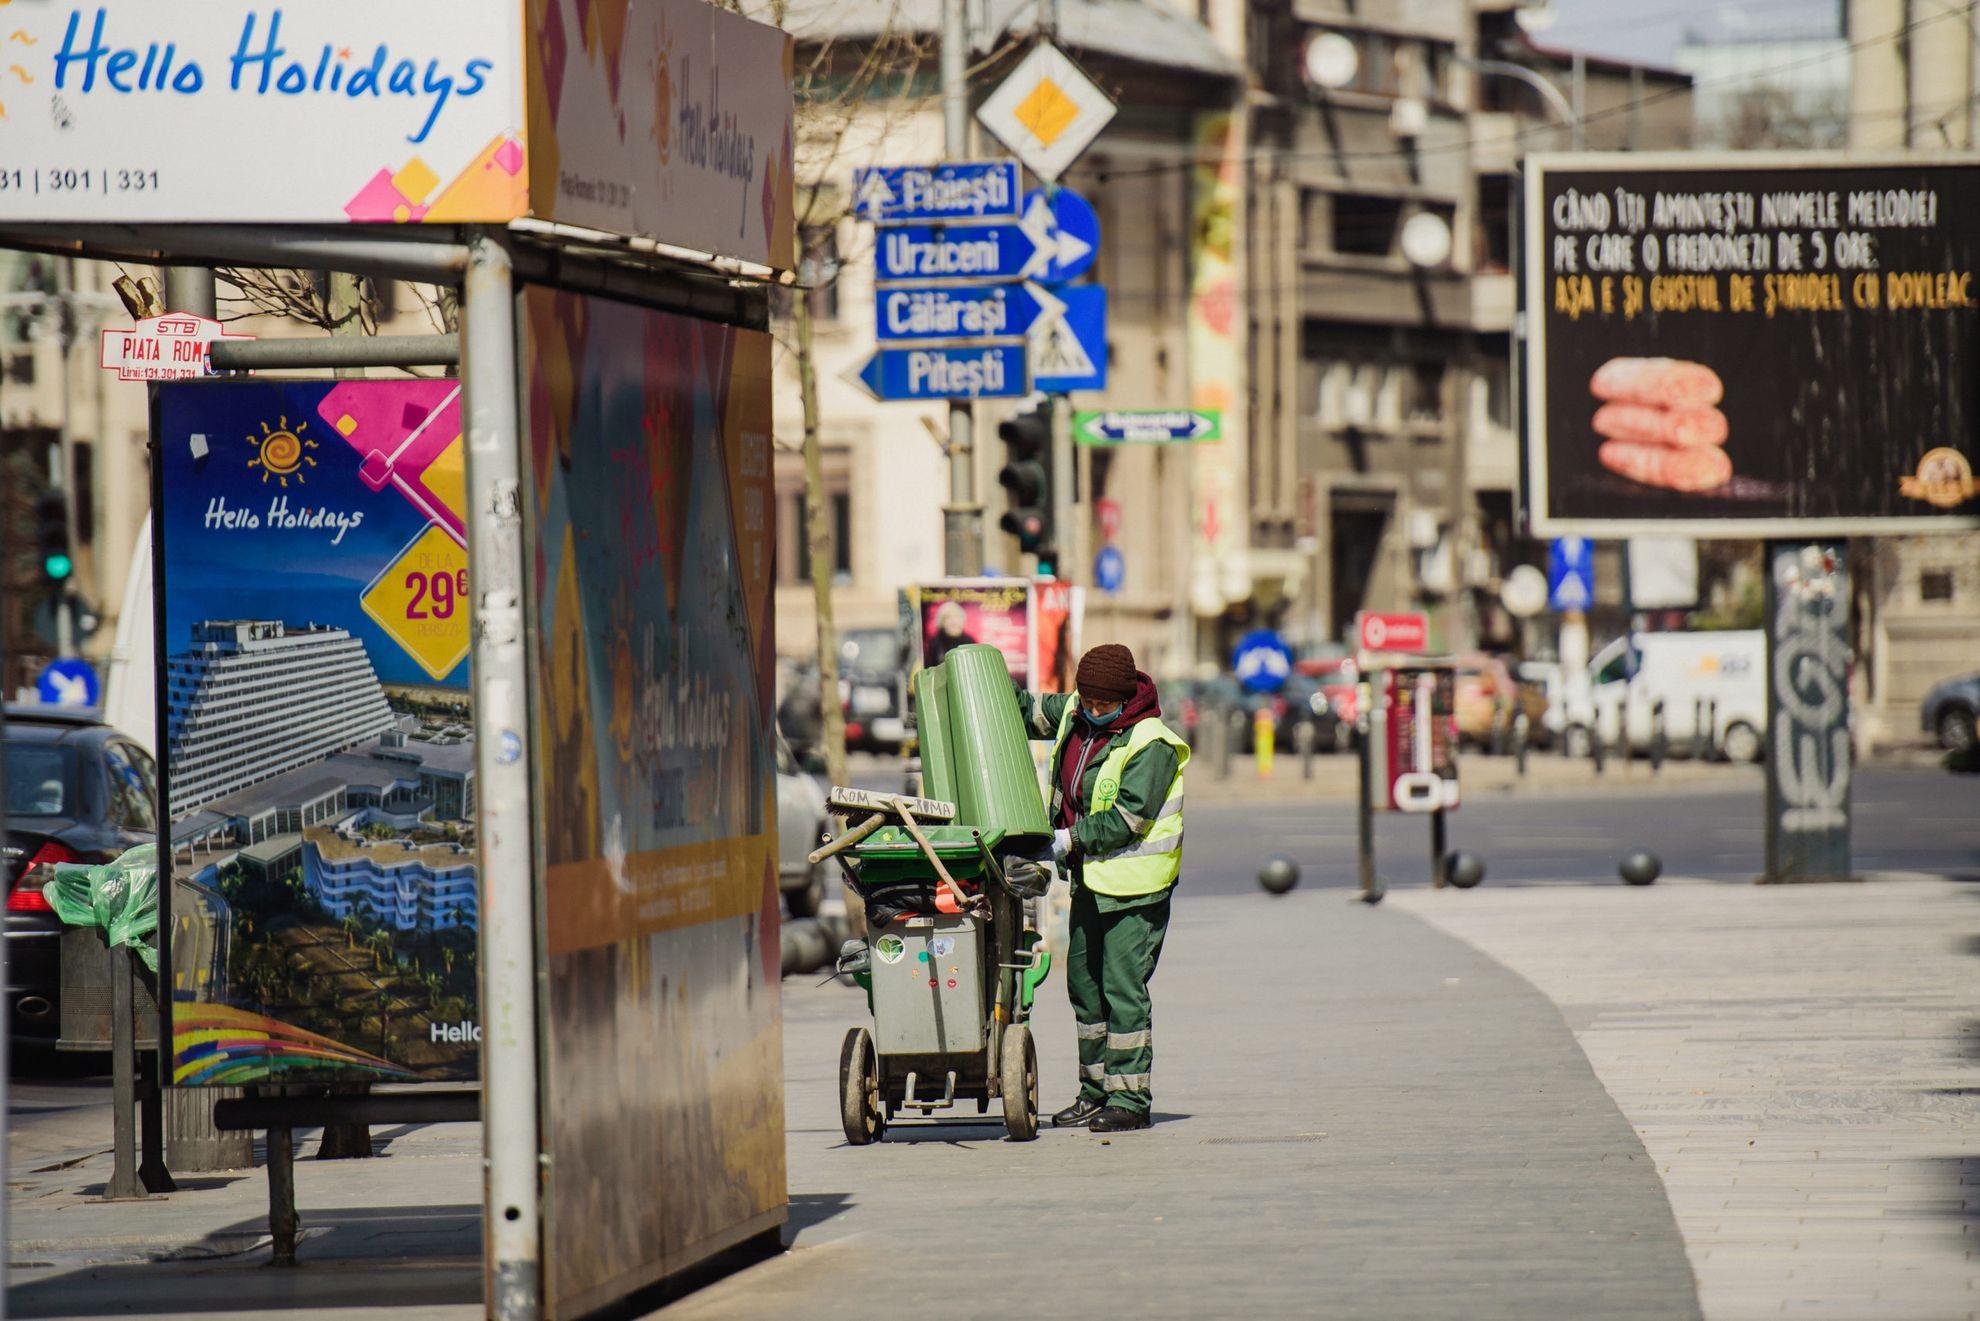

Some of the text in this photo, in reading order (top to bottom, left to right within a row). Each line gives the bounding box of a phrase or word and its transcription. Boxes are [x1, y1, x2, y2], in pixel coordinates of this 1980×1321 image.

[54, 7, 493, 143] Hello Holidays
[50, 169, 90, 190] 301
[118, 169, 159, 190] 331
[1553, 186, 1611, 232] CÂND
[1761, 190, 1840, 229] NUMELE
[1848, 189, 1938, 228] MELODIEI
[886, 231, 1000, 274] Urziceni
[1553, 233, 1578, 273] PE
[1585, 233, 1635, 272] CARE
[1641, 233, 1660, 272] O
[1666, 231, 1771, 272] FREDONEZI
[1778, 231, 1803, 270] DE
[1811, 231, 1828, 270] 5
[887, 288, 1007, 335] Călărași
[1554, 273, 1596, 322] AȘA
[1601, 275, 1615, 314] E
[1650, 273, 1723, 313] GUSTUL
[1729, 272, 1755, 313] DE
[1853, 272, 1881, 310] CU
[122, 338, 161, 361] PIATA
[156, 320, 198, 334] STB
[907, 349, 1005, 398] Pitești
[204, 495, 364, 546] Hello Holidays
